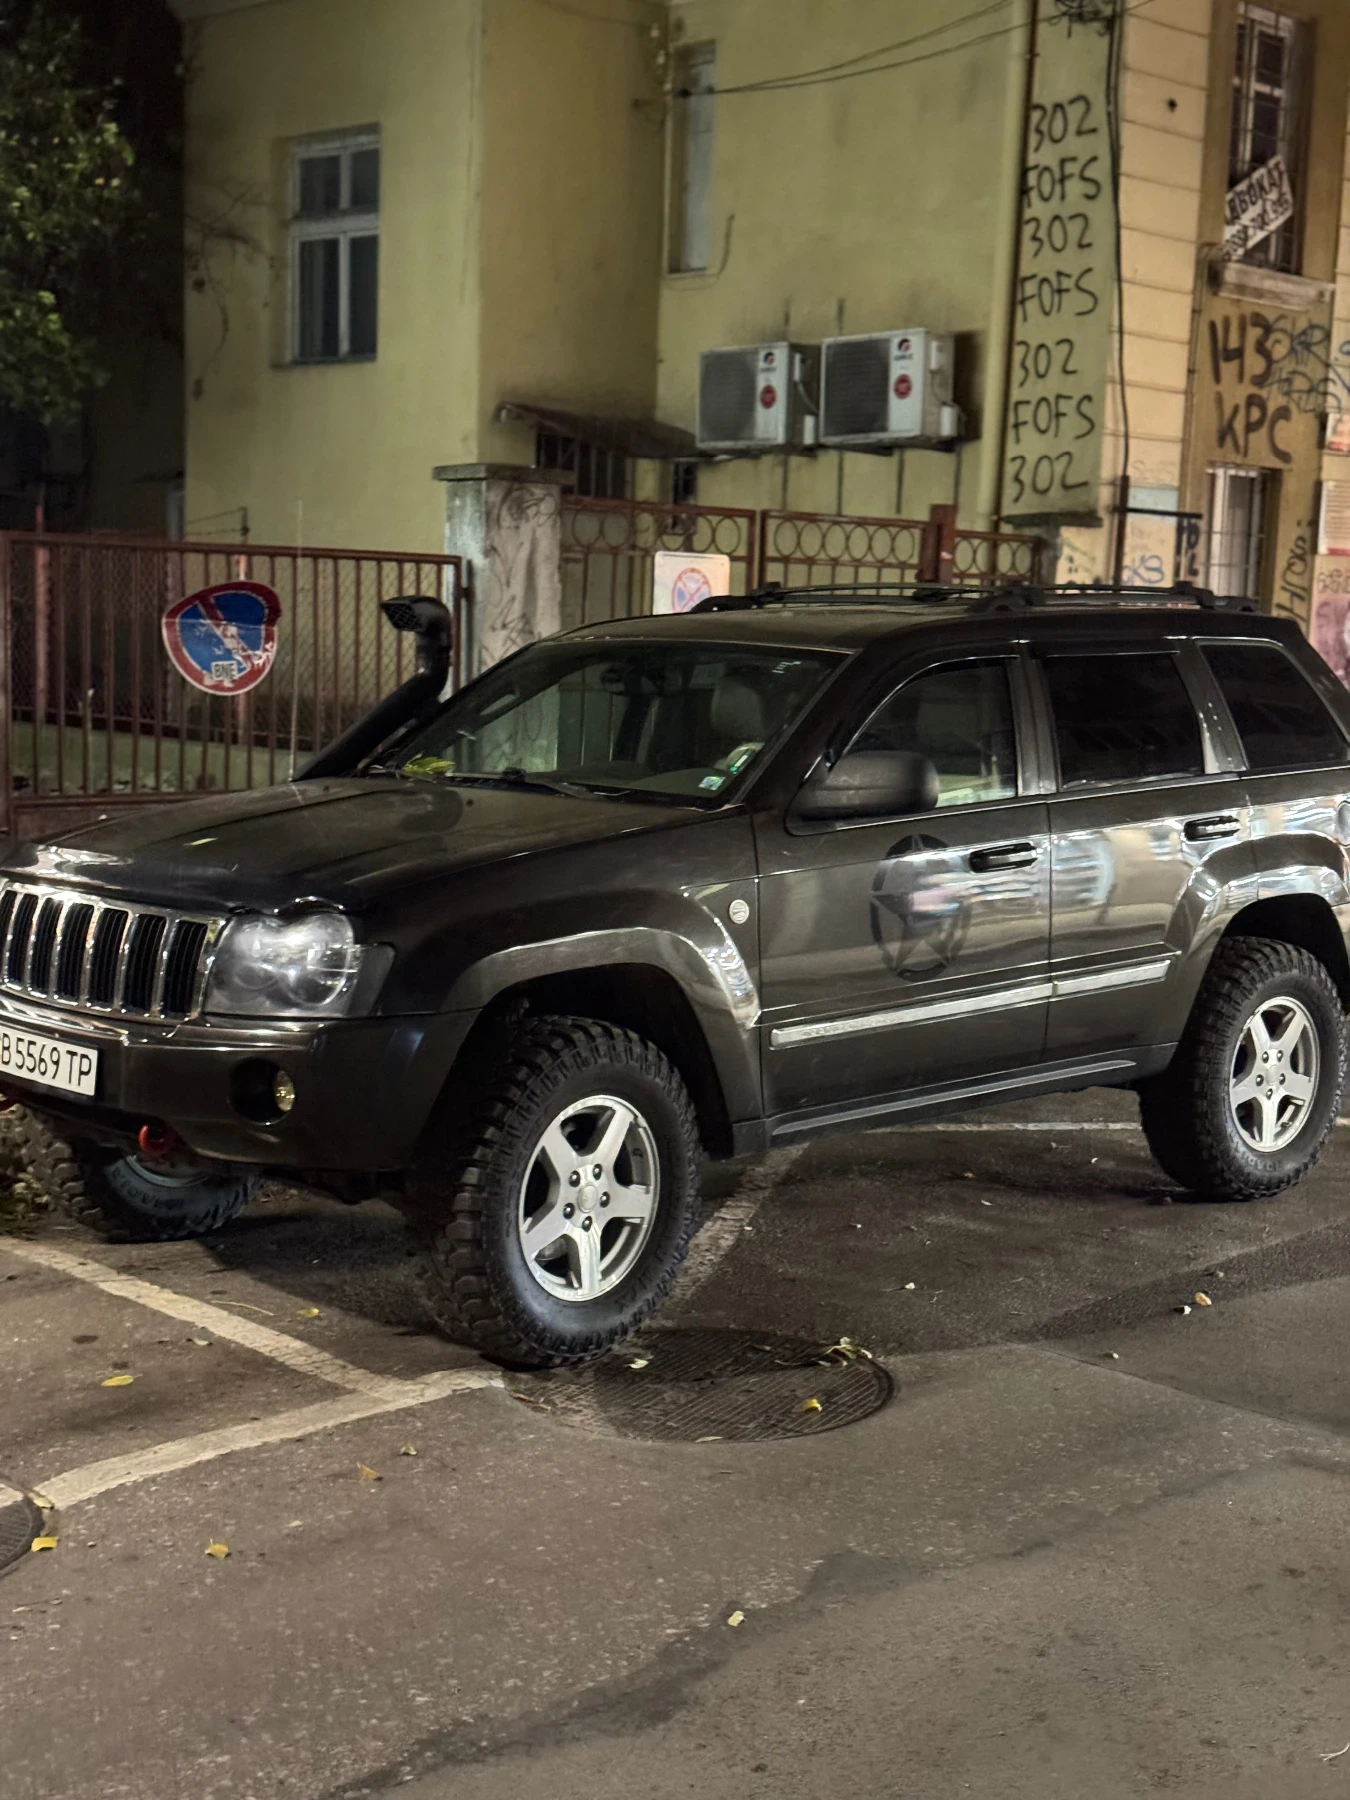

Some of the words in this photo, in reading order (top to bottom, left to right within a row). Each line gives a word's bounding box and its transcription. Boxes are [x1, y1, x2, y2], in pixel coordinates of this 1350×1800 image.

[1031, 94, 1098, 152] 302
[1022, 156, 1102, 208] FOFS
[1024, 213, 1093, 258] 302
[1018, 267, 1099, 323] FOFS
[1016, 338, 1079, 388] 302
[1012, 393, 1096, 445] FOFS
[1010, 451, 1089, 504] 302
[15, 1036, 61, 1080] 5569
